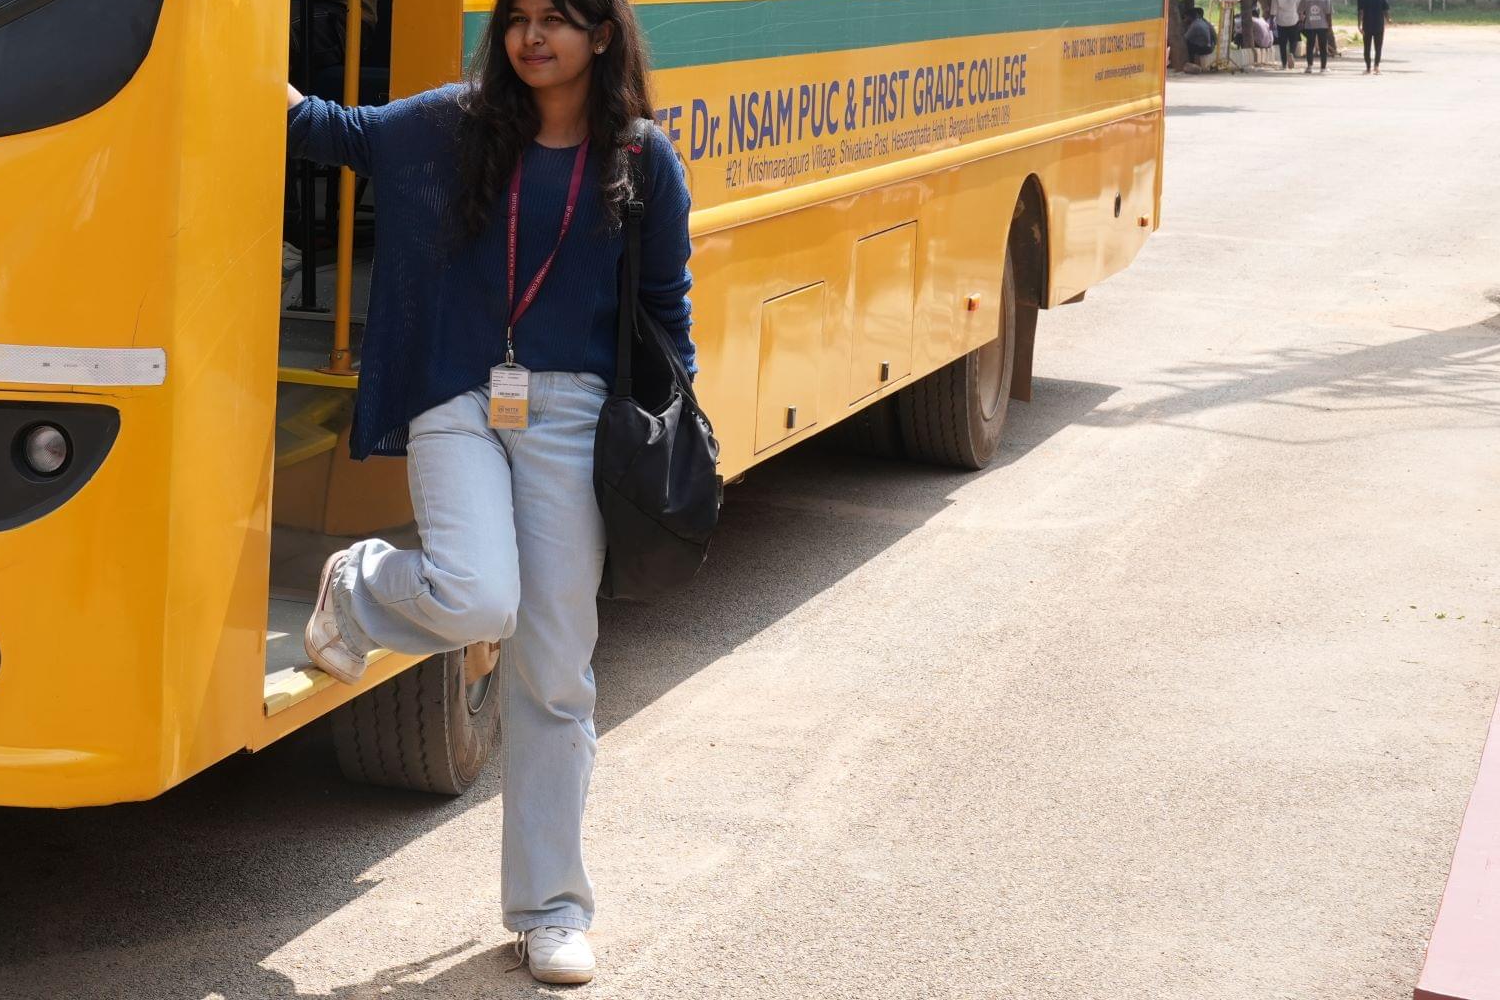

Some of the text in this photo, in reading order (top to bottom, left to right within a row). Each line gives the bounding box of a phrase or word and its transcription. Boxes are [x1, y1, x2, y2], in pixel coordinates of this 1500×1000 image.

[690, 98, 722, 161] Dr.
[728, 87, 794, 155] NSAM
[798, 80, 840, 141] PUC
[844, 78, 856, 131] &
[862, 70, 910, 129] FIRST
[913, 60, 965, 117] GRADE
[968, 53, 1028, 103] COLLEGE
[747, 153, 810, 187] Krishnarajapura
